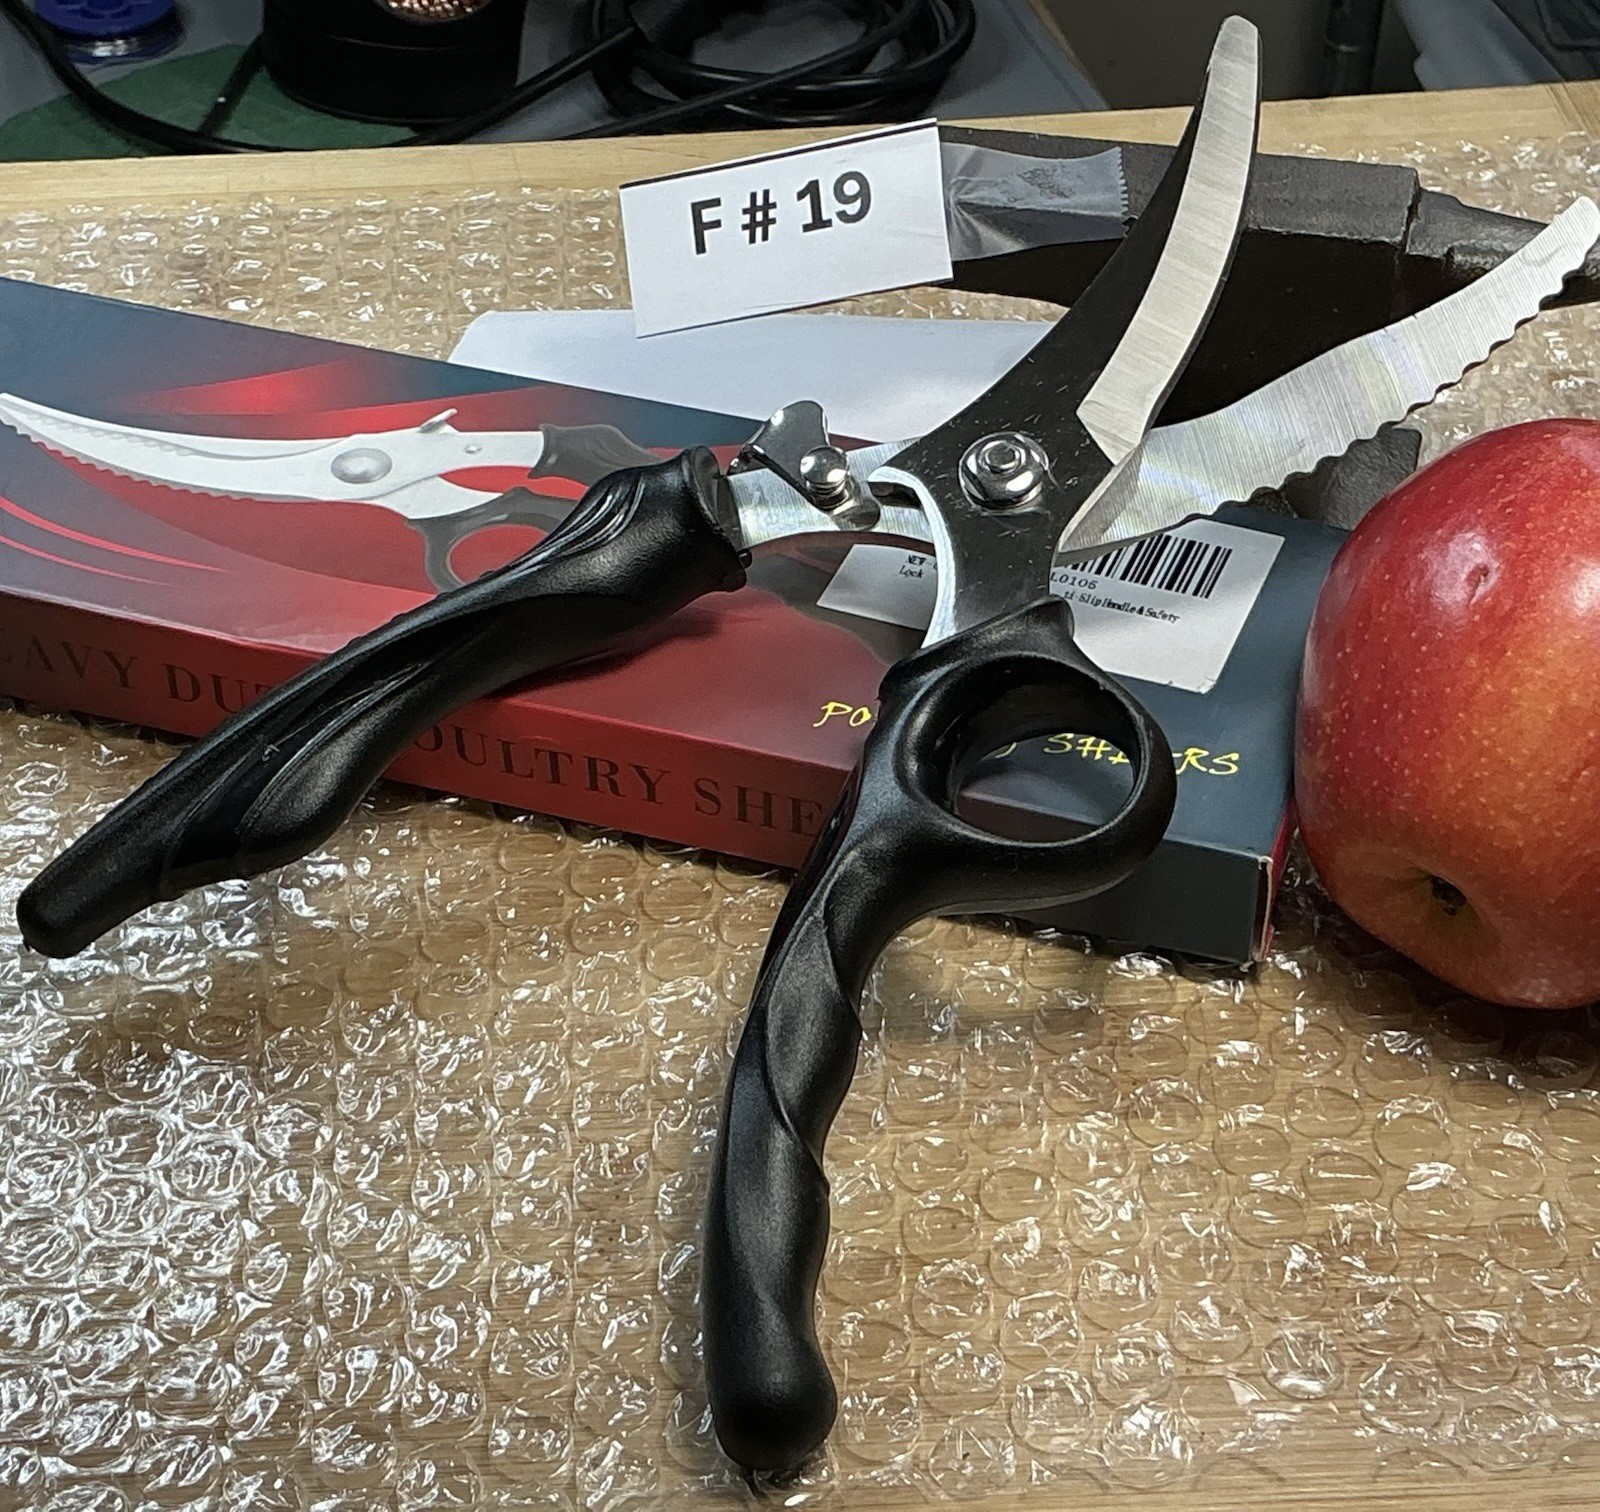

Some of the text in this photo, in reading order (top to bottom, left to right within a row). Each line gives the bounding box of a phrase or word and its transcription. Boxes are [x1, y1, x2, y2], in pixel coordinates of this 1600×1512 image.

[690, 170, 872, 256] F # 19
[0, 628, 272, 714] AVY DU
